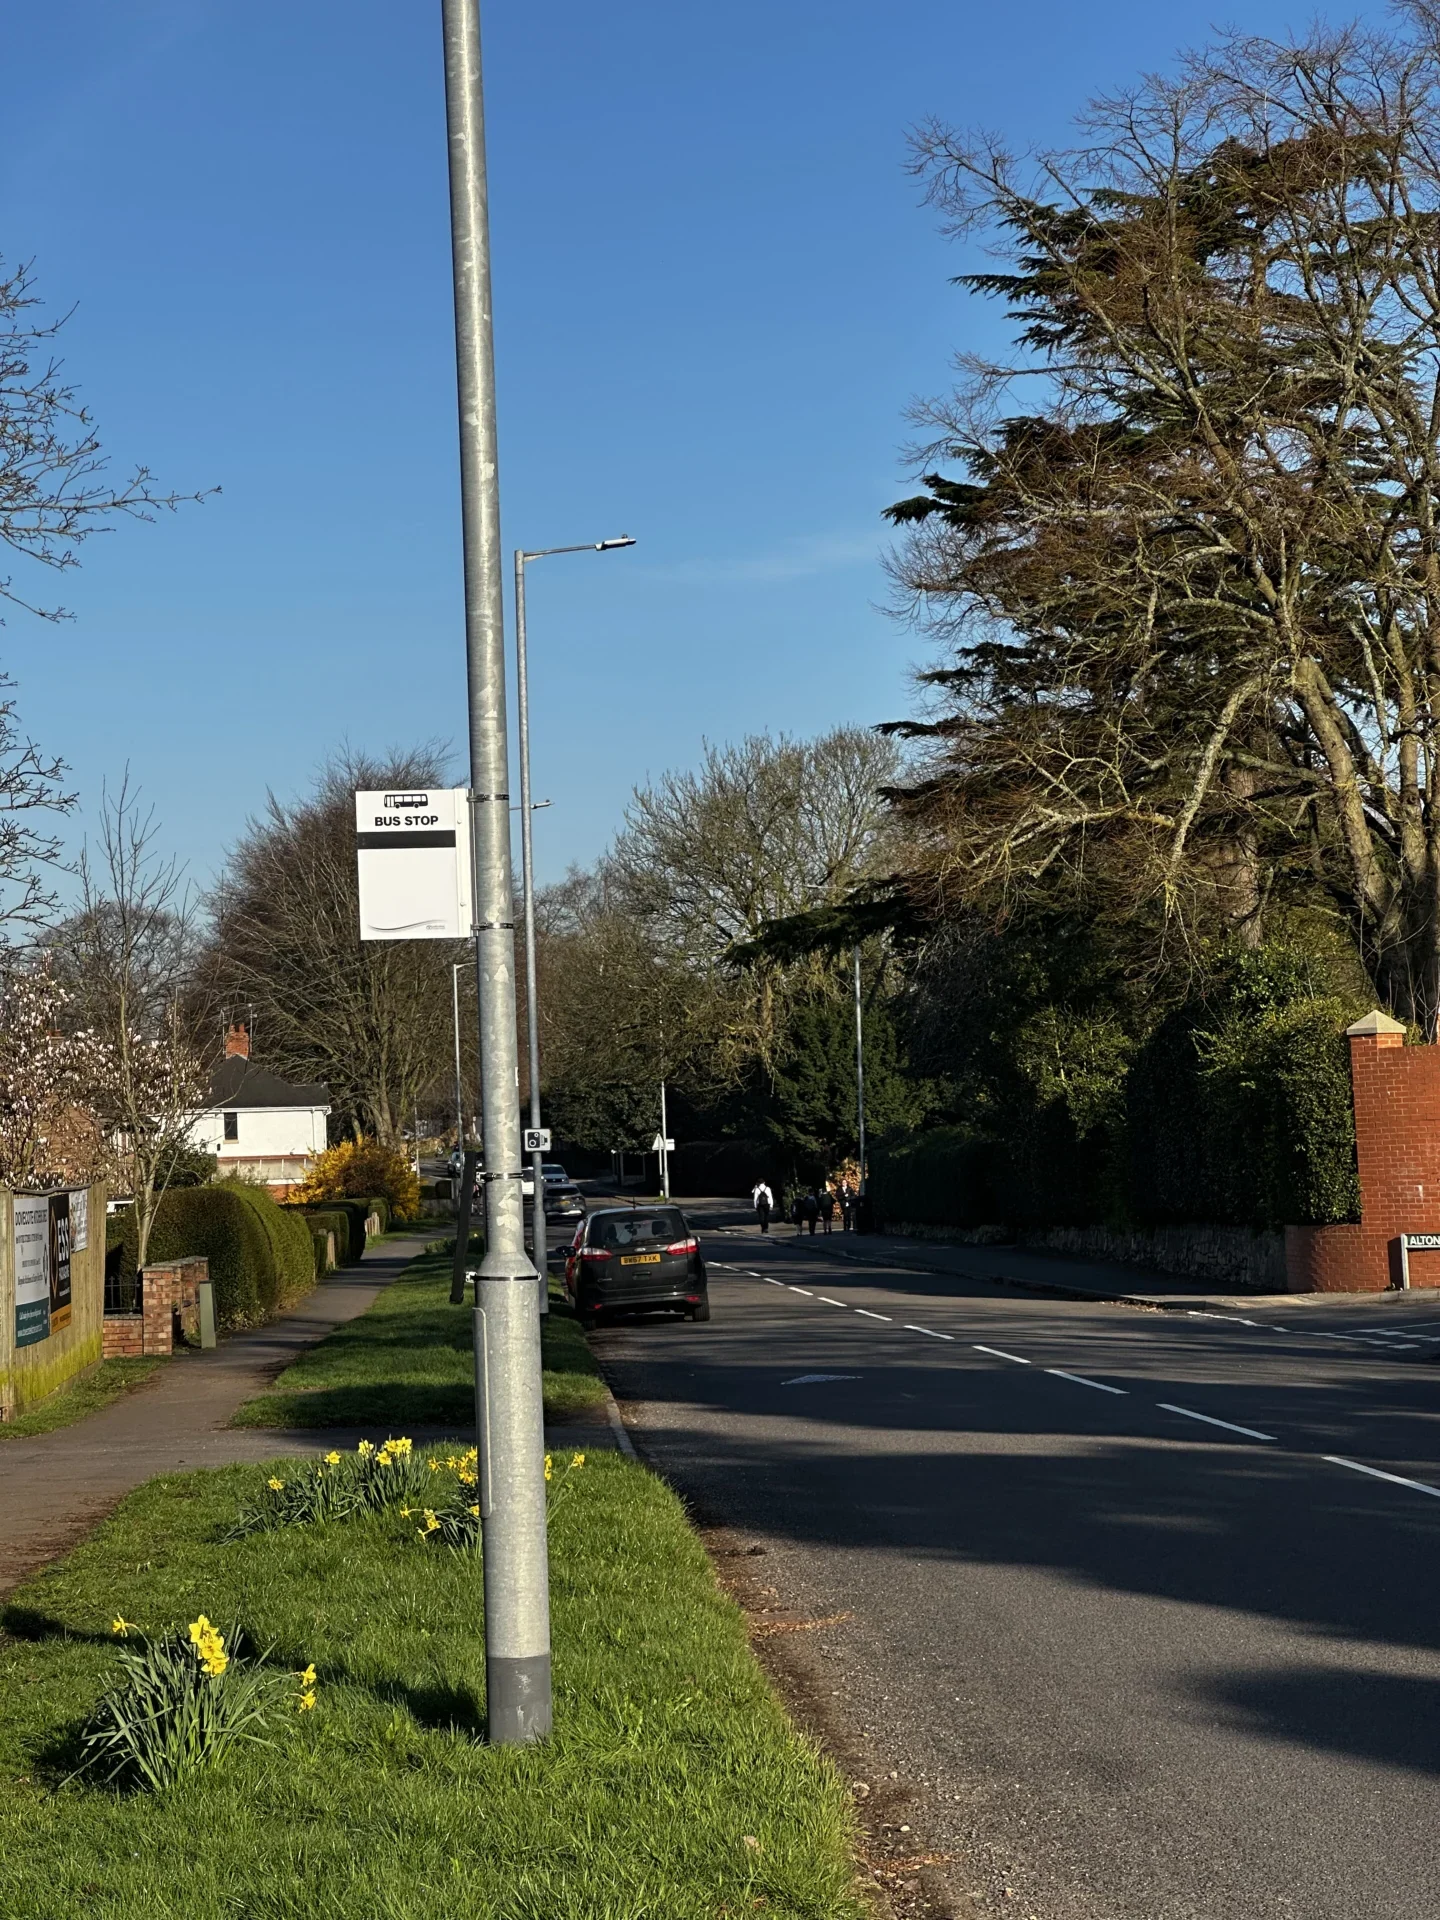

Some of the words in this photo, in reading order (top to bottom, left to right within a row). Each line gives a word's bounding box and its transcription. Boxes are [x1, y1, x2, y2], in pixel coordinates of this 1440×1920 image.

[375, 816, 401, 827] BUS
[404, 815, 439, 826] STOP
[57, 1217, 69, 1262] ESS
[1410, 1235, 1440, 1246] ALTON
